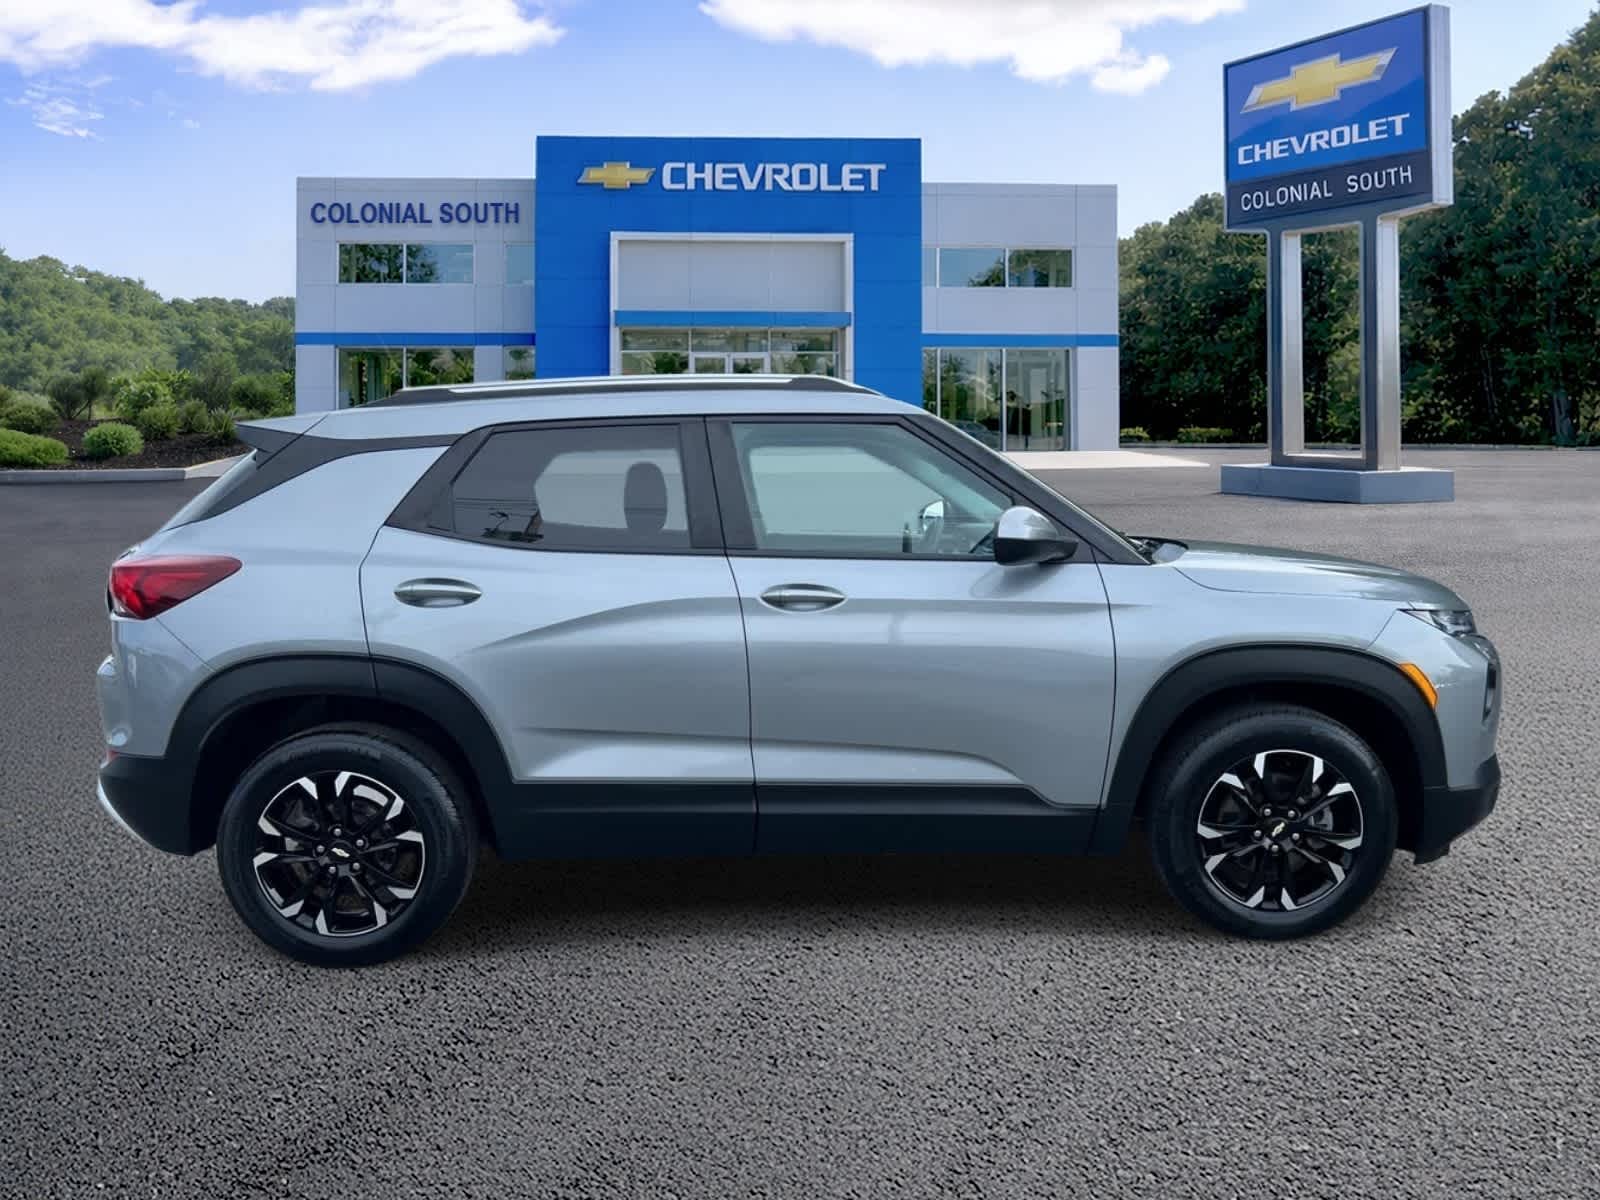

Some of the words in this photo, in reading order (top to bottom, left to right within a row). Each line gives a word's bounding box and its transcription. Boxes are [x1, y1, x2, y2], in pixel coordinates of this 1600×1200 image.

[1238, 113, 1410, 165] CHEVROLET
[662, 162, 887, 192] CHEVROLET
[1241, 182, 1333, 211] COLONIAL
[1346, 165, 1412, 193] SOUTH
[310, 202, 432, 224] COLONIAL
[439, 202, 520, 224] SOUTH
